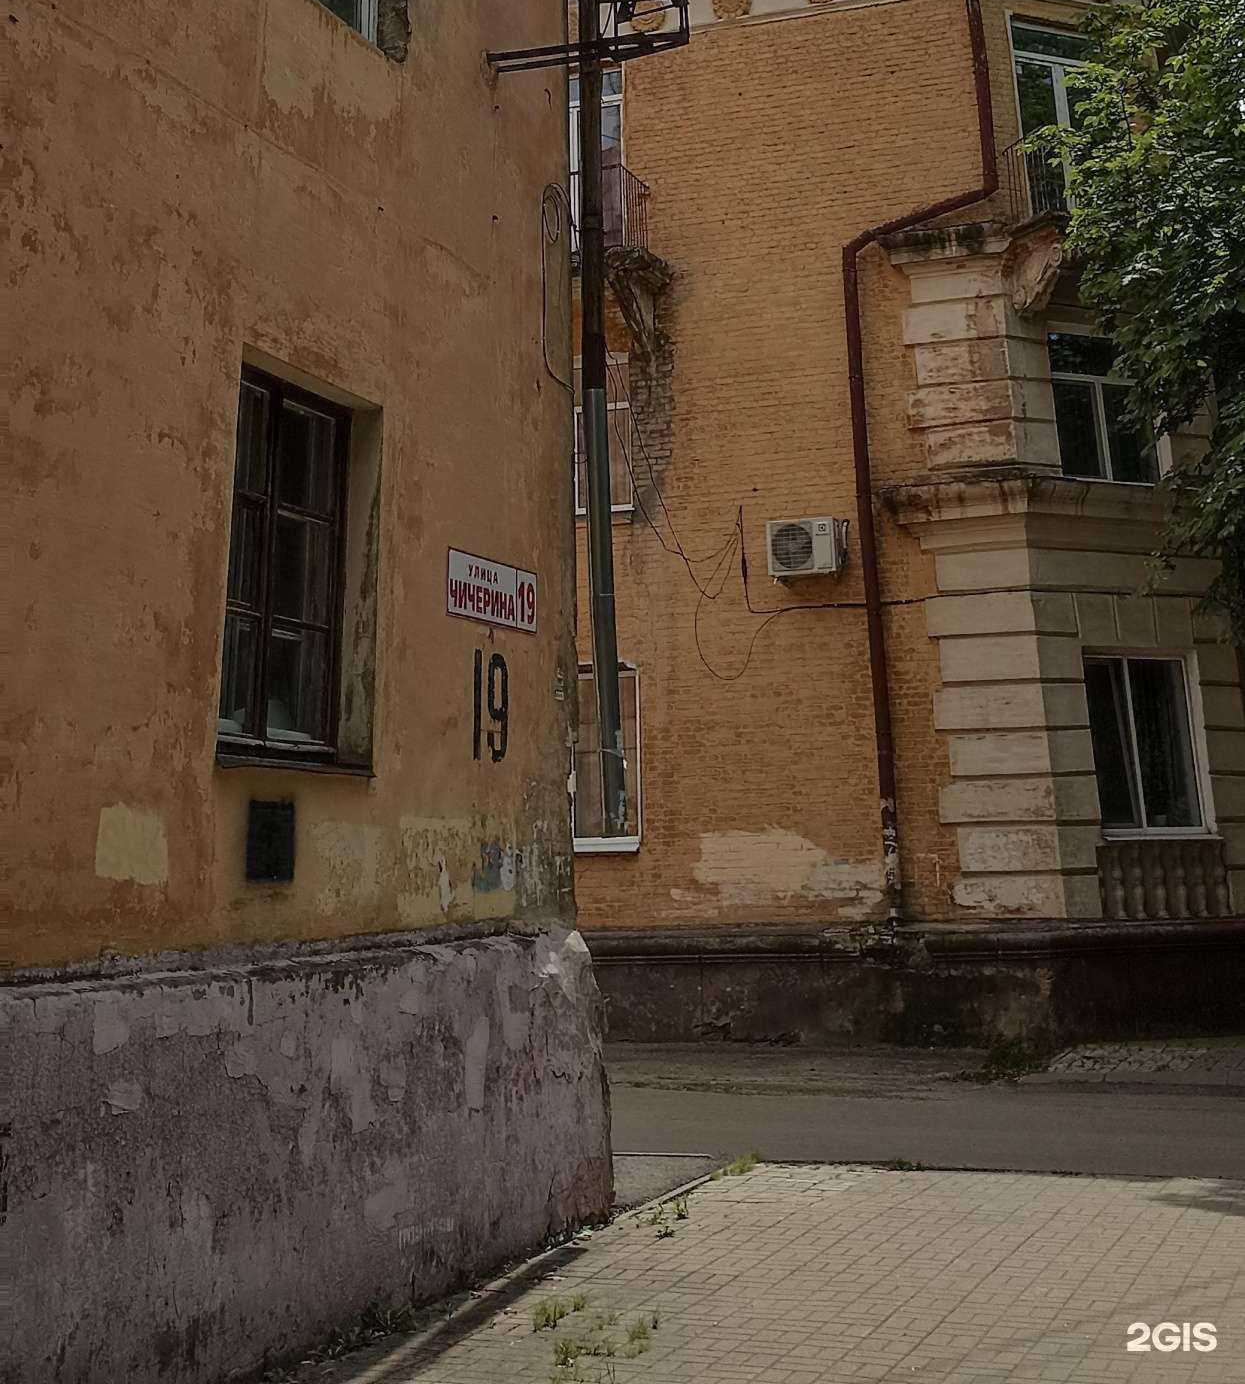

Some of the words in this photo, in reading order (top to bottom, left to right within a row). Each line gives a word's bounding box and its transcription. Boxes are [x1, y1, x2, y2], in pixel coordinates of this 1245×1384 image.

[468, 565, 499, 583] УЛИЦА
[449, 579, 515, 621] ЧИЧЕРИНА
[518, 582, 535, 625] 19
[473, 648, 508, 763] 19
